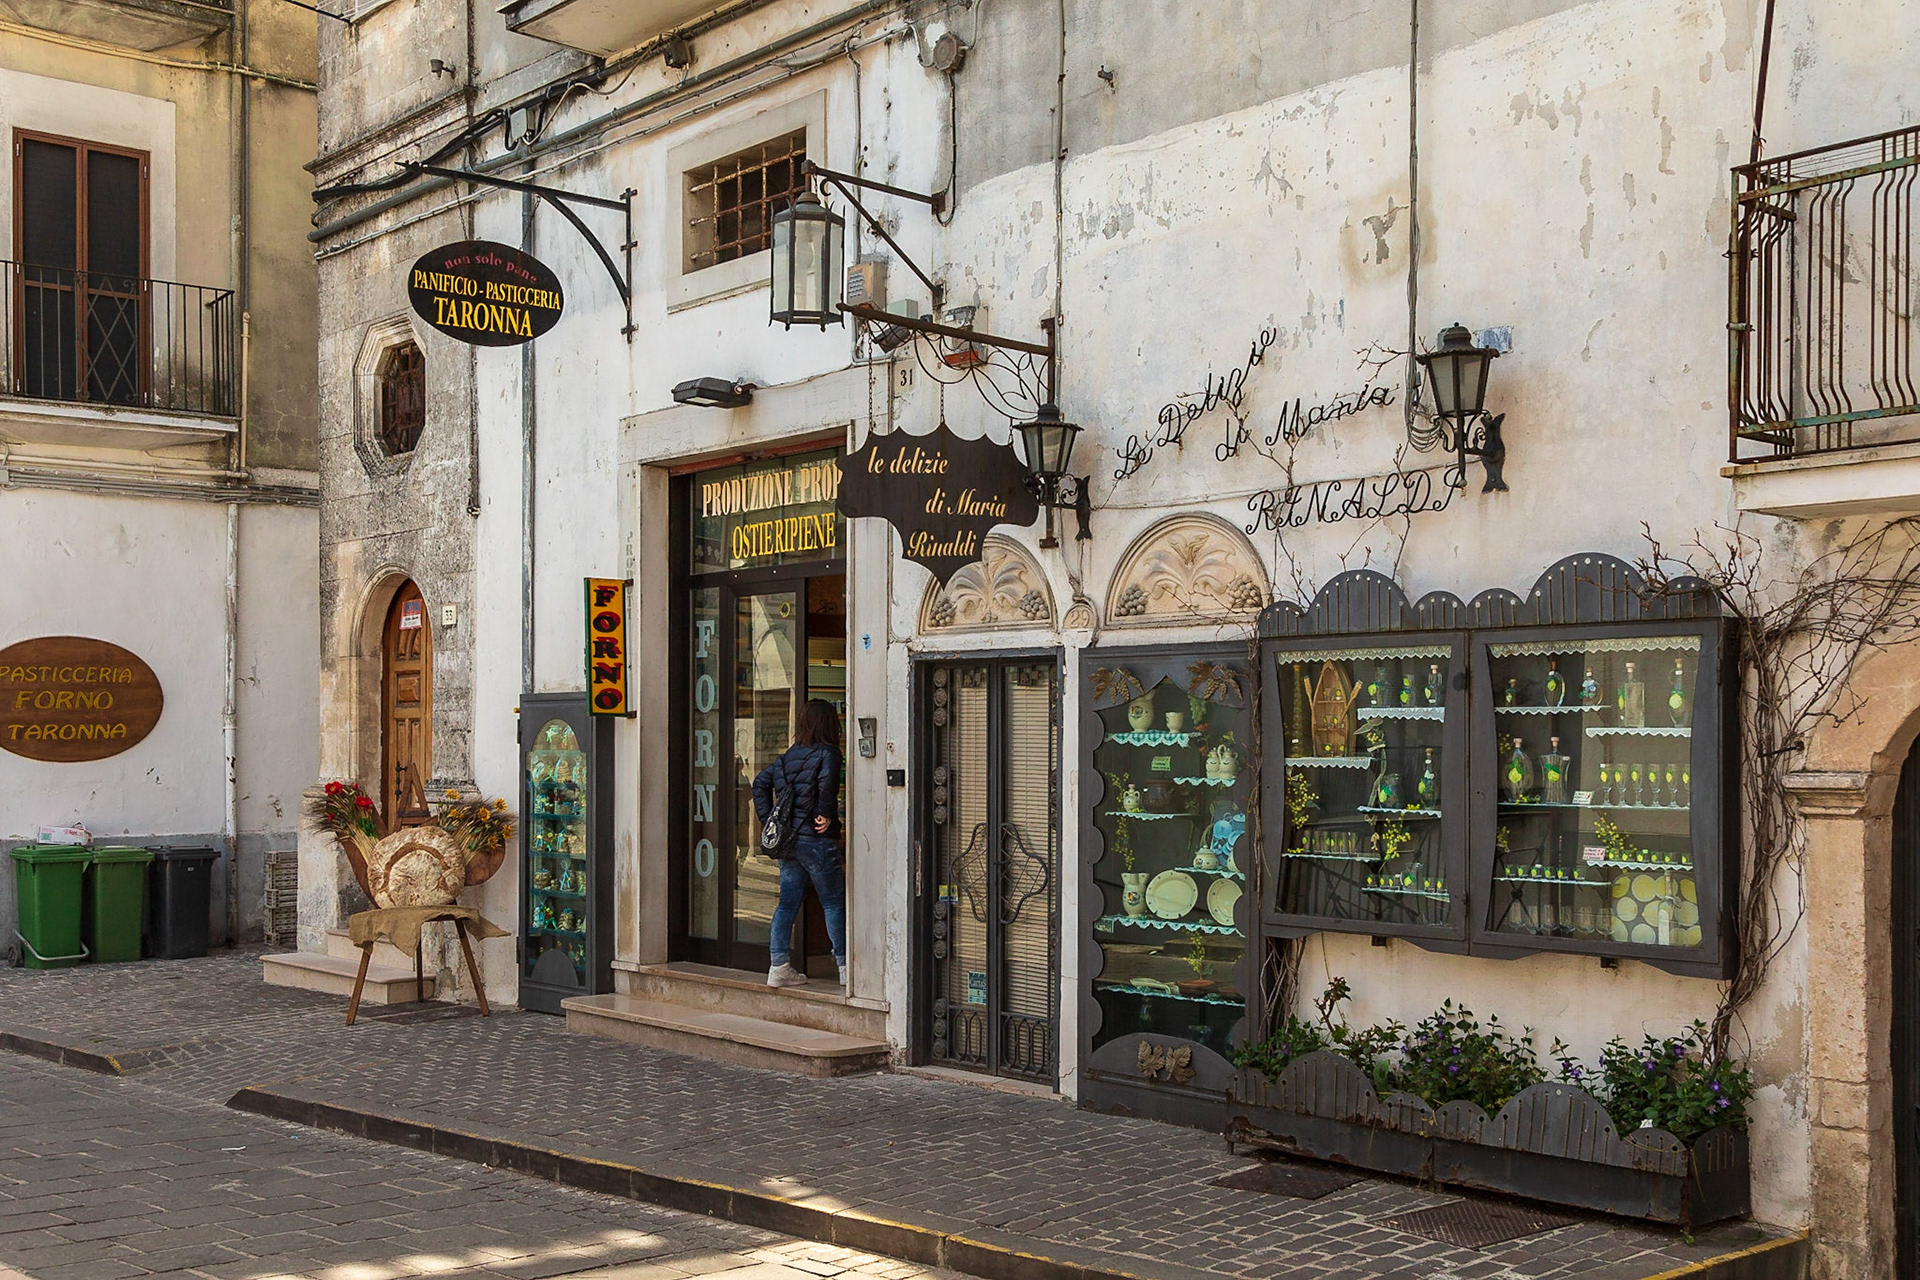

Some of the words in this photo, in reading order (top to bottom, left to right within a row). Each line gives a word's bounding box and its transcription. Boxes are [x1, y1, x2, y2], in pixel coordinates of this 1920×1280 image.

[444, 255, 471, 270] non
[474, 251, 503, 266] solo
[506, 260, 538, 284] pane
[413, 269, 478, 297] PANIFICIO
[485, 281, 561, 311] PASTICCERIA
[433, 296, 534, 338] TARONNA
[900, 368, 914, 388] 31
[1215, 418, 1250, 463] di
[1265, 383, 1396, 447] Maria
[867, 446, 884, 474] le
[889, 446, 949, 474] delizie
[1114, 434, 1154, 480] Le
[702, 470, 793, 518] PRODUZIONE
[925, 487, 946, 515] di
[947, 488, 1007, 518] Maria
[1246, 467, 1463, 535] RINALDI
[907, 530, 977, 558] Rinaldi
[445, 609, 453, 621] 33
[1070, 609, 1091, 628] 29
[592, 585, 624, 710] FORNO
[0, 665, 133, 684] PASTICCERIA
[15, 690, 114, 709] FORNO
[7, 722, 127, 740] TARONNA
[693, 619, 716, 878] FORNO
